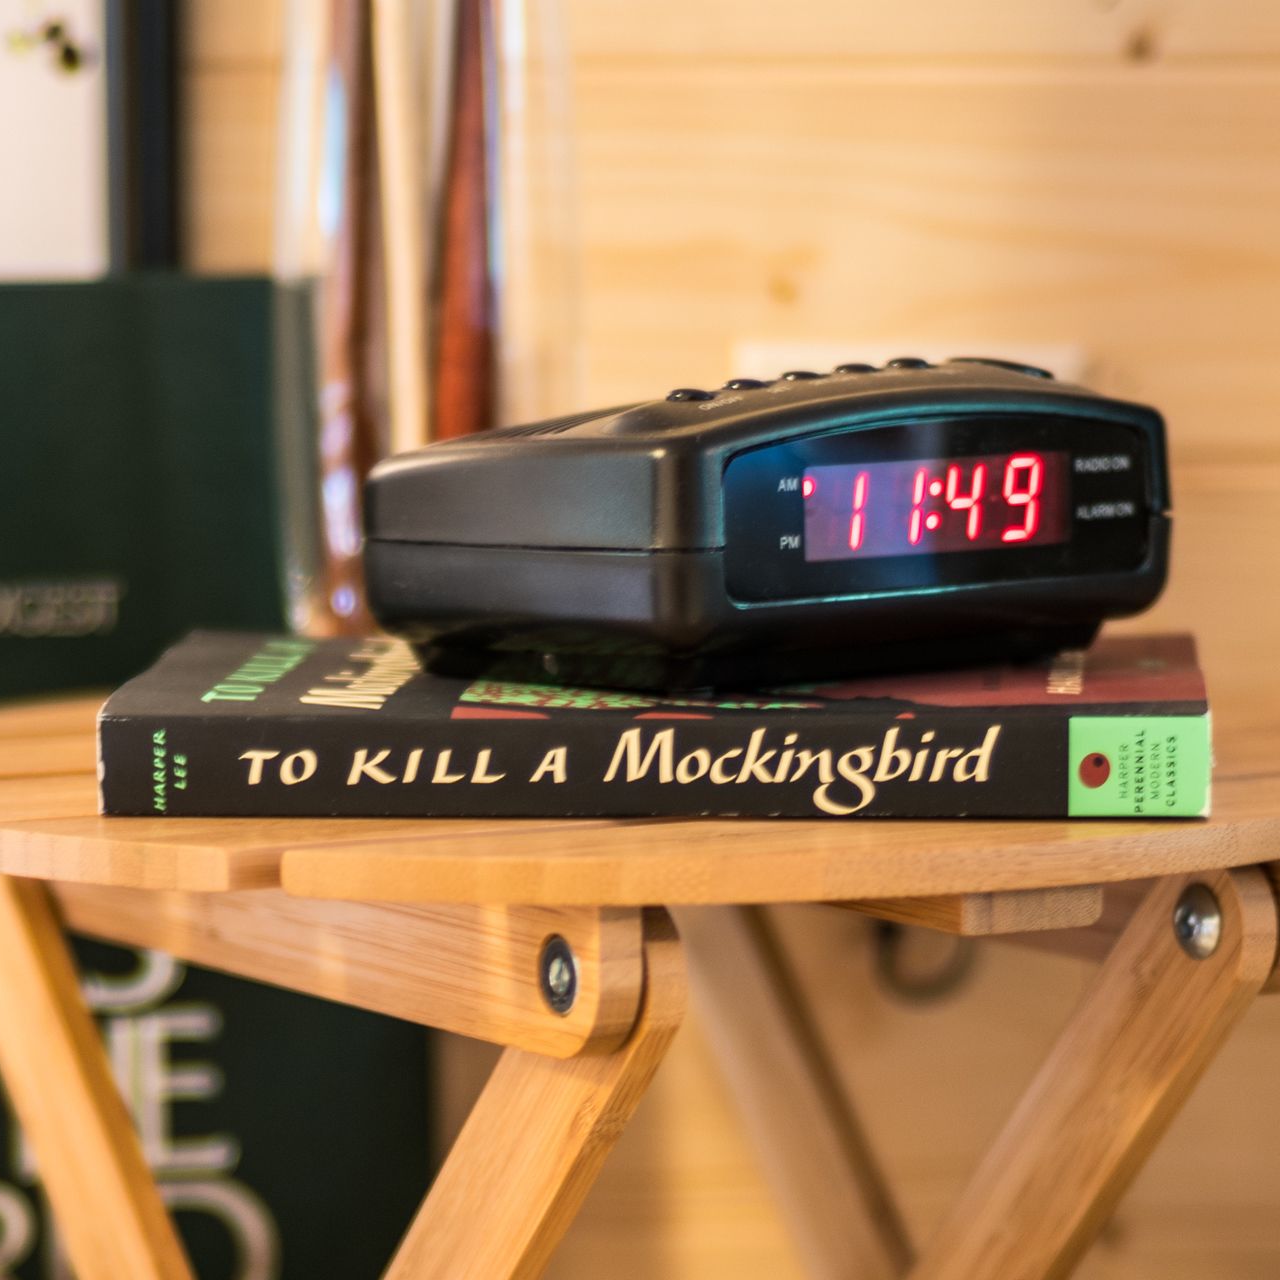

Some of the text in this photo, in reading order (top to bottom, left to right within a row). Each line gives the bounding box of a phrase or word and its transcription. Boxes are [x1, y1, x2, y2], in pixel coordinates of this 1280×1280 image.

[777, 476, 799, 493] AM
[849, 449, 1044, 550] 11:49
[780, 535, 800, 550] PM
[153, 727, 167, 811] HARPER
[173, 753, 188, 790] LEE
[237, 724, 1003, 816] TO KILL A Mockingbird
[1118, 743, 1130, 799] HARPER
[1134, 729, 1147, 814] PERENNIAL
[1150, 742, 1162, 800] MODERN
[1166, 735, 1178, 808] CLASSICS
